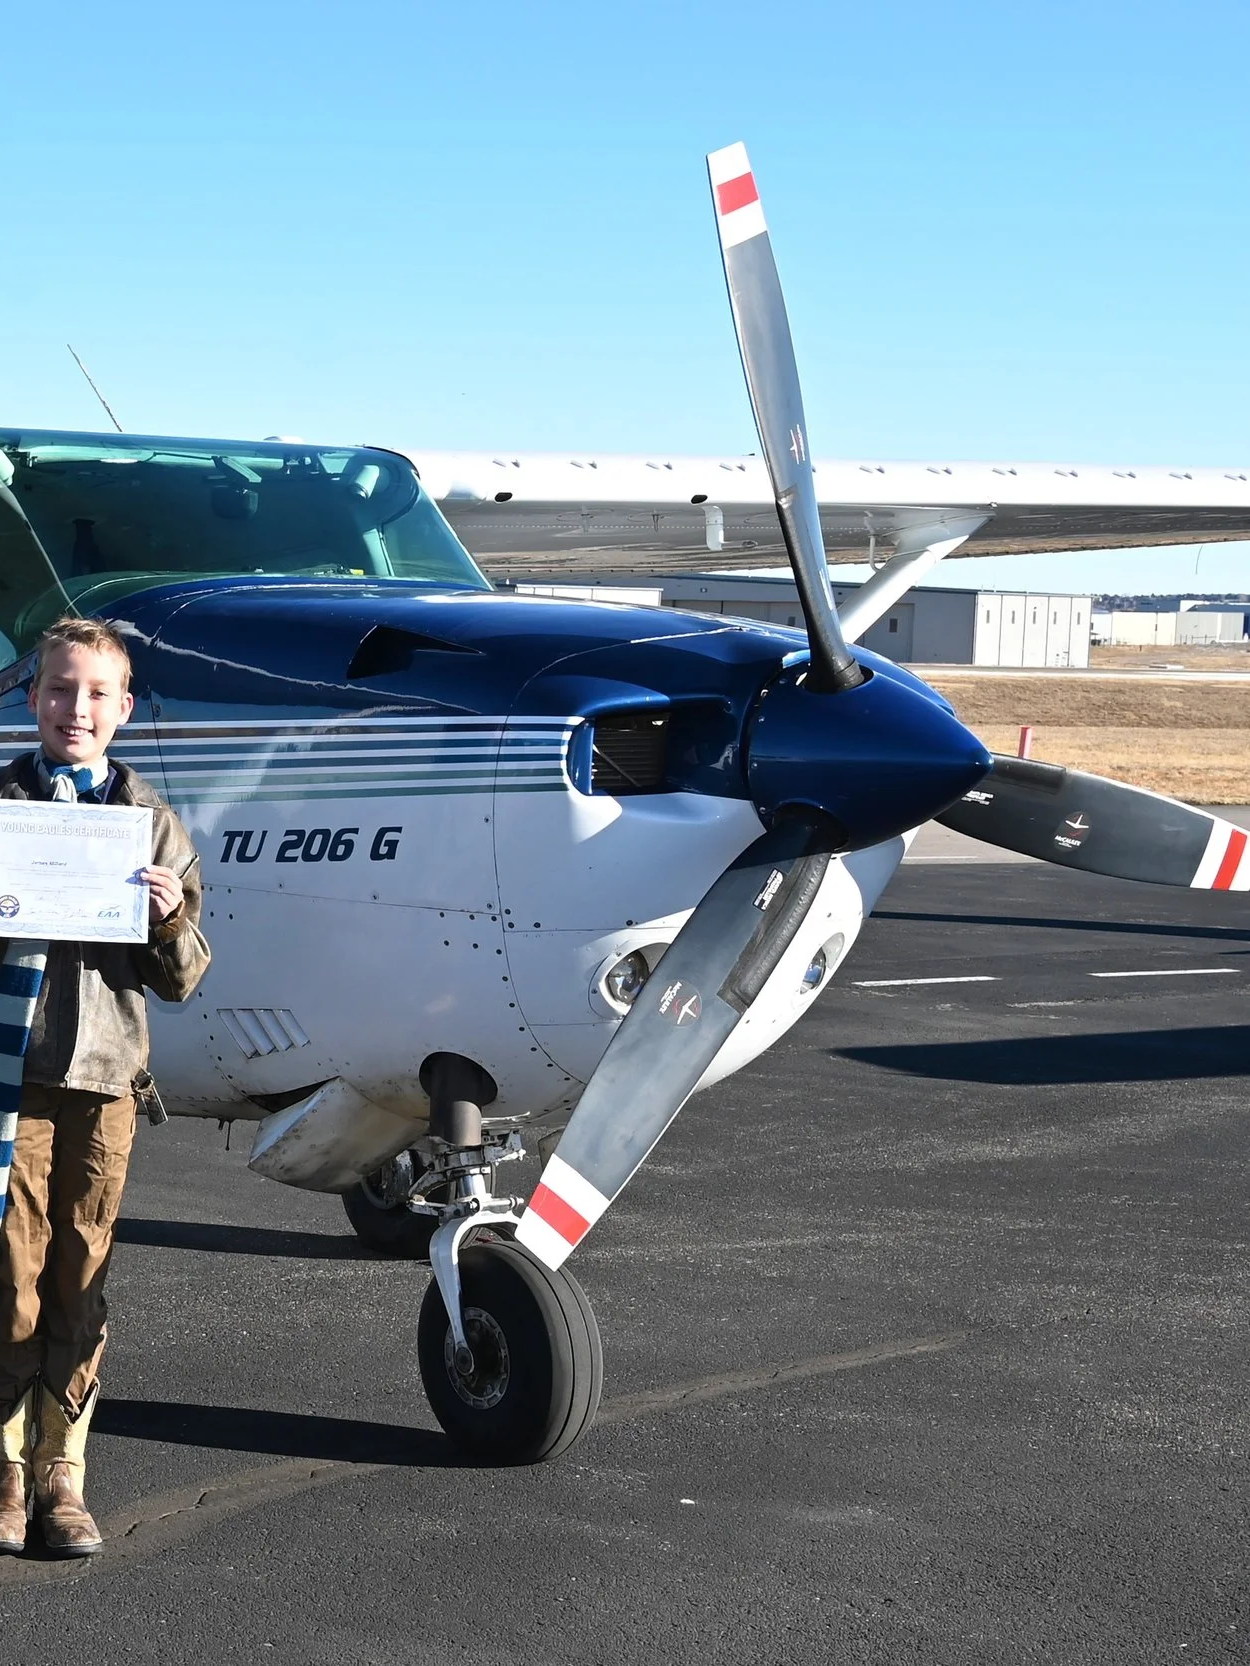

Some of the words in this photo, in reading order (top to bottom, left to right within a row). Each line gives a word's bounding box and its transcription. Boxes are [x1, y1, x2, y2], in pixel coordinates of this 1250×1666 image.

[0, 821, 35, 834] YOUNG
[36, 823, 72, 836] EAGLES
[73, 825, 131, 840] CERTIFICATE
[220, 830, 268, 863] TU
[275, 827, 359, 863] 206
[370, 826, 403, 861] G
[97, 910, 120, 918] EAA
